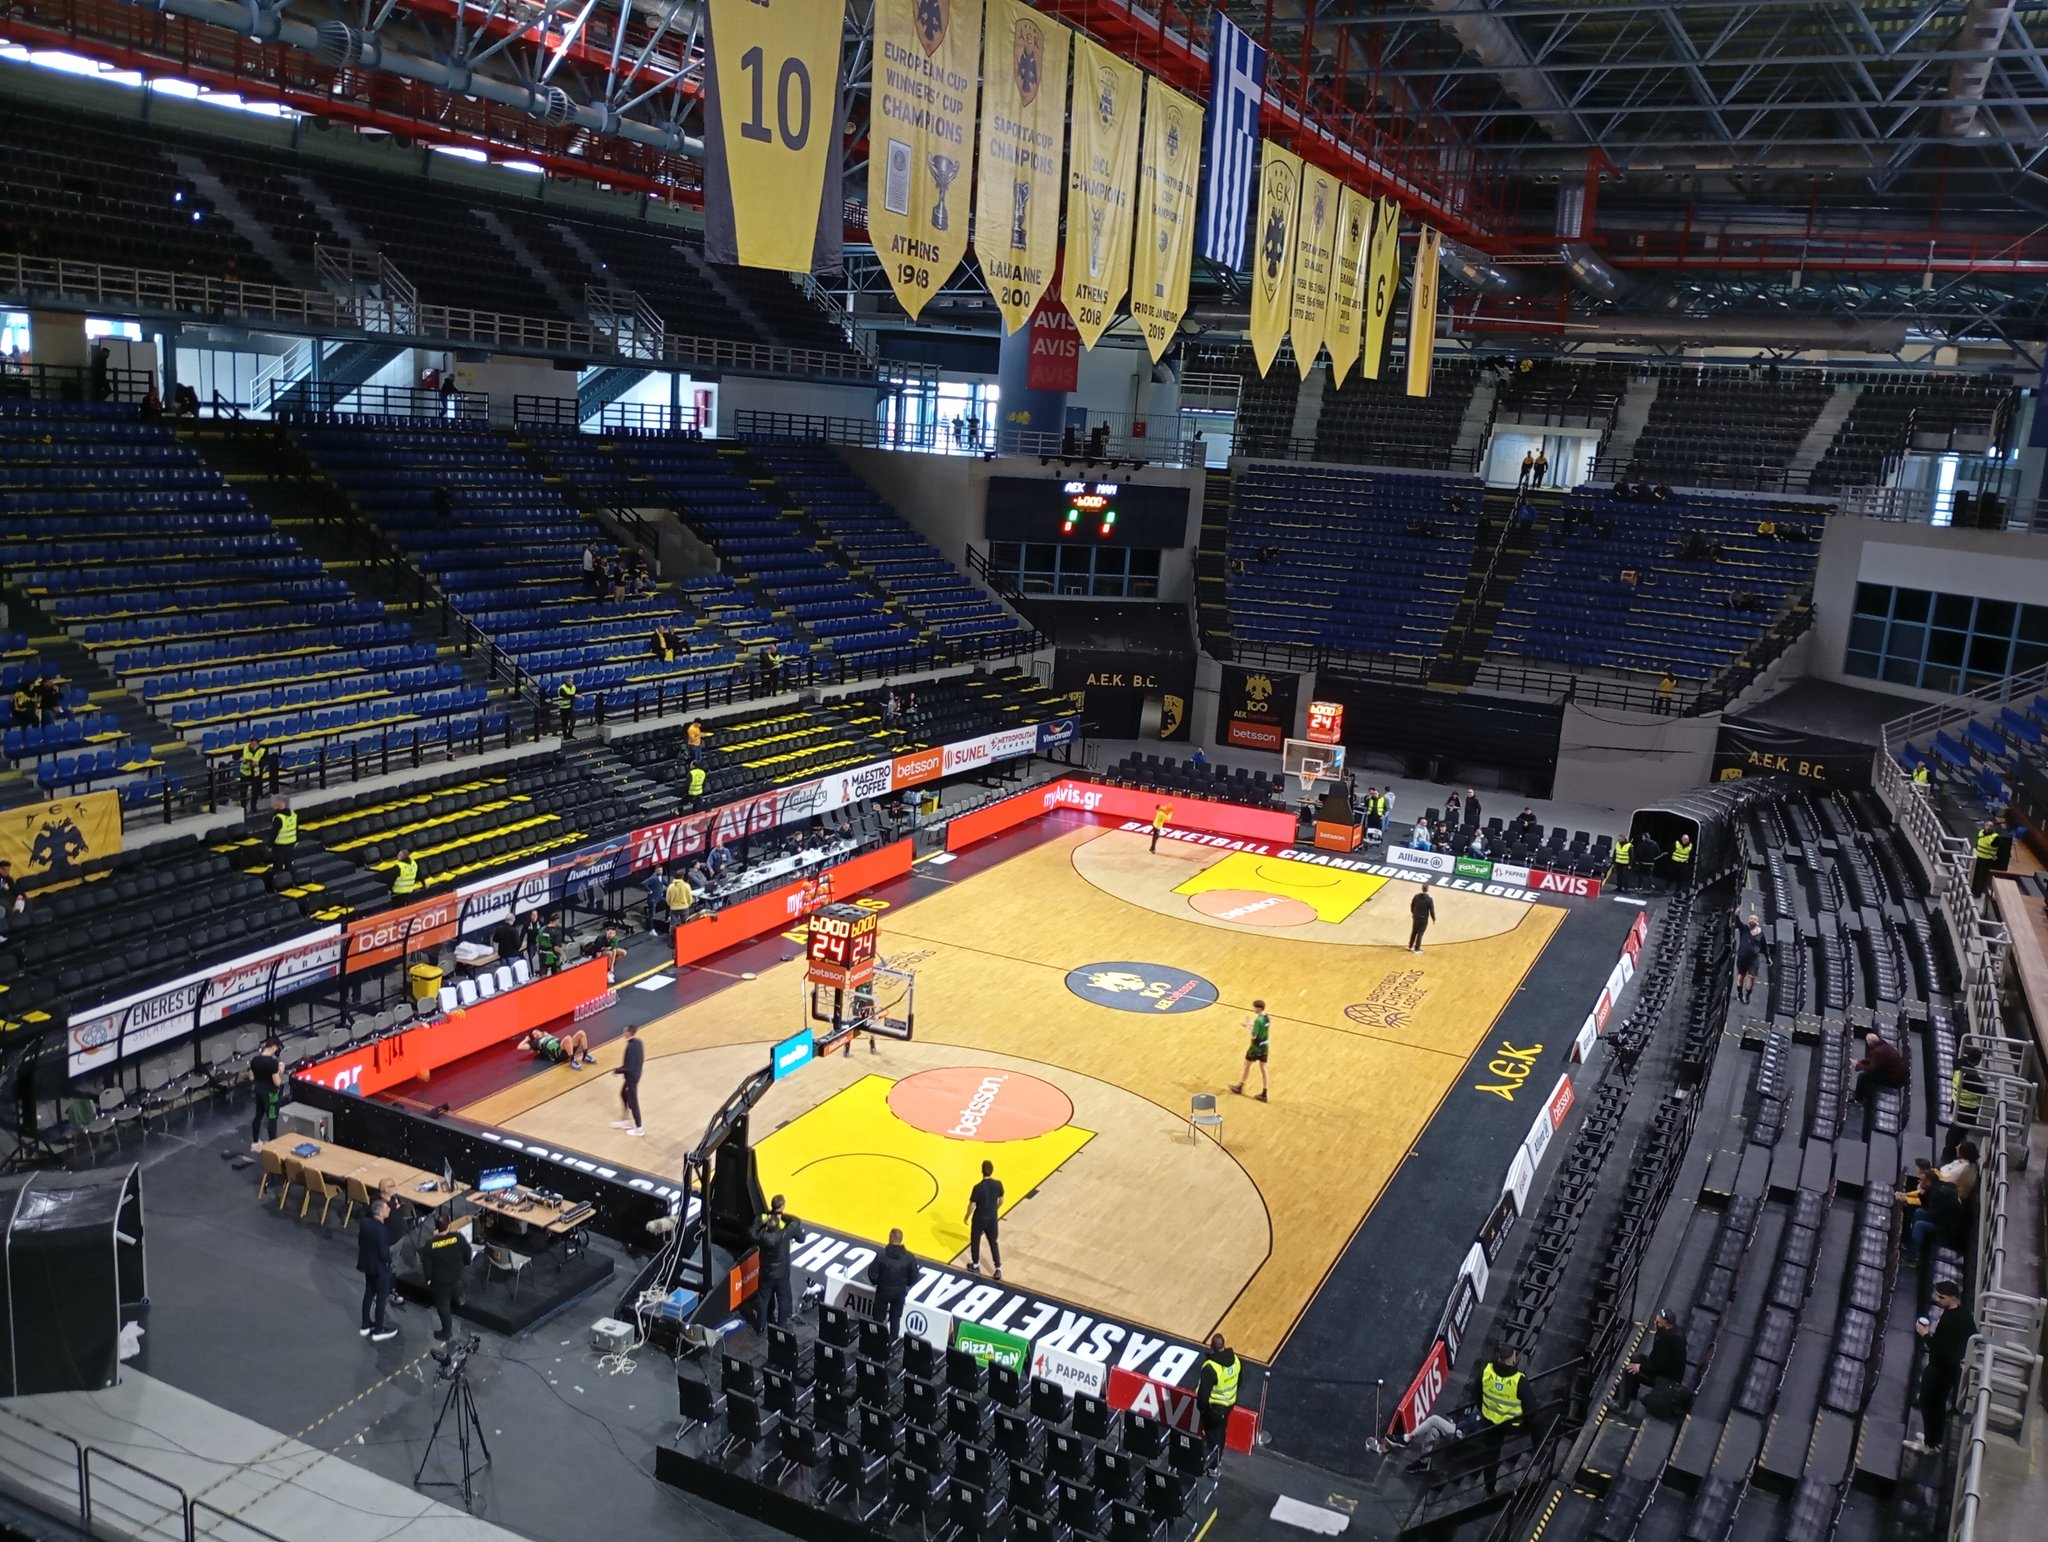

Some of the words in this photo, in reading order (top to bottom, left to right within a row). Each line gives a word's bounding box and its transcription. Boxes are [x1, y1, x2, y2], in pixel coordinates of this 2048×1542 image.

[884, 41, 944, 81] EUROPEAN
[946, 71, 968, 94] CUP
[740, 46, 812, 151] 10
[886, 68, 940, 105] WINNERS'
[942, 92, 964, 116] CUP
[882, 95, 963, 145] CHAMPIONS
[1036, 133, 1053, 149] CUP
[891, 235, 940, 263] ATHENS
[898, 263, 929, 289] 1968
[1075, 283, 1108, 305] ATHENS
[1375, 274, 1386, 318] 6
[1034, 310, 1077, 331] AVIS
[1079, 306, 1101, 326] 2018
[1134, 302, 1148, 315] RIO
[1149, 304, 1155, 316] DE
[1155, 308, 1178, 324] JANEIRO
[1149, 323, 1165, 341] 2019
[1032, 337, 1076, 358] AVIS
[1064, 482, 1086, 493] AEK
[1087, 673, 1125, 687] A.E.K.
[1133, 676, 1158, 688] B.C.
[1234, 710, 1247, 719] AEK
[1246, 700, 1268, 712] 100
[1310, 704, 1336, 715] 6000
[1311, 714, 1332, 729] 24
[997, 729, 1036, 745] METROPOLITAN
[997, 739, 1036, 752] GENERAL
[1233, 728, 1276, 742] betsson
[955, 744, 988, 765] SUNEL
[1748, 750, 1789, 773] A.E.K.
[1798, 761, 1826, 781] B.C.
[851, 765, 891, 786] MAESTRO
[896, 756, 939, 779] betsson
[855, 780, 887, 798] COFFEE
[1043, 783, 1103, 810] myAvis.gr
[716, 799, 776, 842] AVIS
[635, 822, 707, 867] AVIS
[1119, 821, 1275, 856] BASKETBALL
[1276, 849, 1431, 884] CHAMPIONS
[1436, 876, 1541, 903] LEAGUE
[1398, 852, 1429, 867] Allianz
[1505, 869, 1527, 880] PAPPAS
[1540, 873, 1588, 897] AVIS
[465, 888, 521, 921] Allianz
[358, 907, 448, 952] betsson
[809, 915, 850, 939] 6000
[851, 914, 876, 937] 6000
[812, 934, 845, 962] 24
[852, 933, 873, 961] 24
[237, 950, 338, 992] GEERAL
[809, 965, 845, 982] betsson
[850, 967, 873, 982] betsson
[1166, 979, 1200, 1002] betsson
[1366, 970, 1404, 1002] BASKETBALL
[1382, 968, 1425, 1006] CHAMPIONS
[1401, 986, 1428, 1010] LEAGUE
[133, 989, 183, 1027] ENERES
[1551, 1087, 1573, 1123] betsson
[1055, 1362, 1099, 1388] PAPPAS
[1413, 1356, 1443, 1427] AVIS
[1130, 1382, 1200, 1435] AVI
